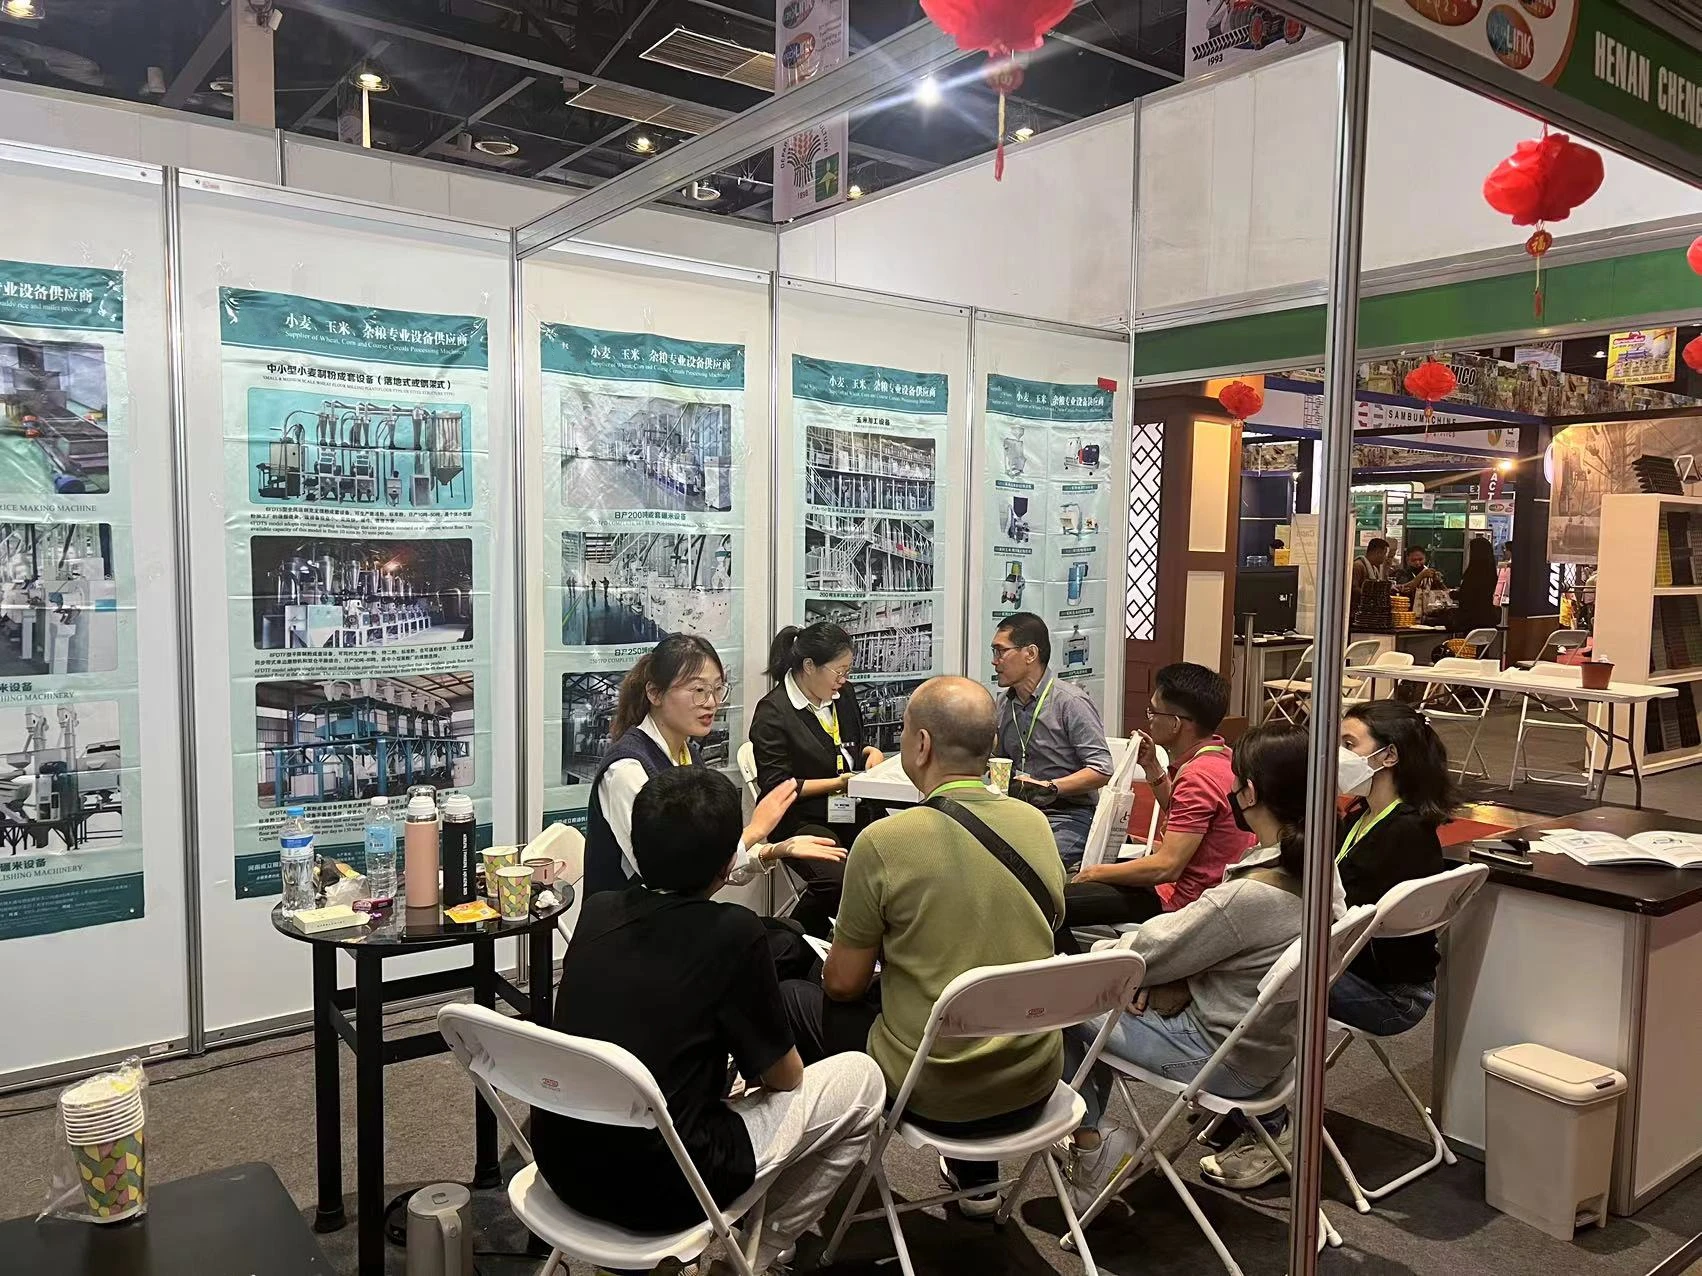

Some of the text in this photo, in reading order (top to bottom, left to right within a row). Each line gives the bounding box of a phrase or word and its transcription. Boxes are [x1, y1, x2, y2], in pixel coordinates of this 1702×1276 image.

[1207, 54, 1223, 66] 1993
[1595, 31, 1650, 102] HENAN
[0, 281, 93, 303] 业设备供应商
[0, 682, 32, 693] 米设备
[24, 692, 75, 701] MACHINERY
[0, 865, 83, 881] ISHING MACHINERY
